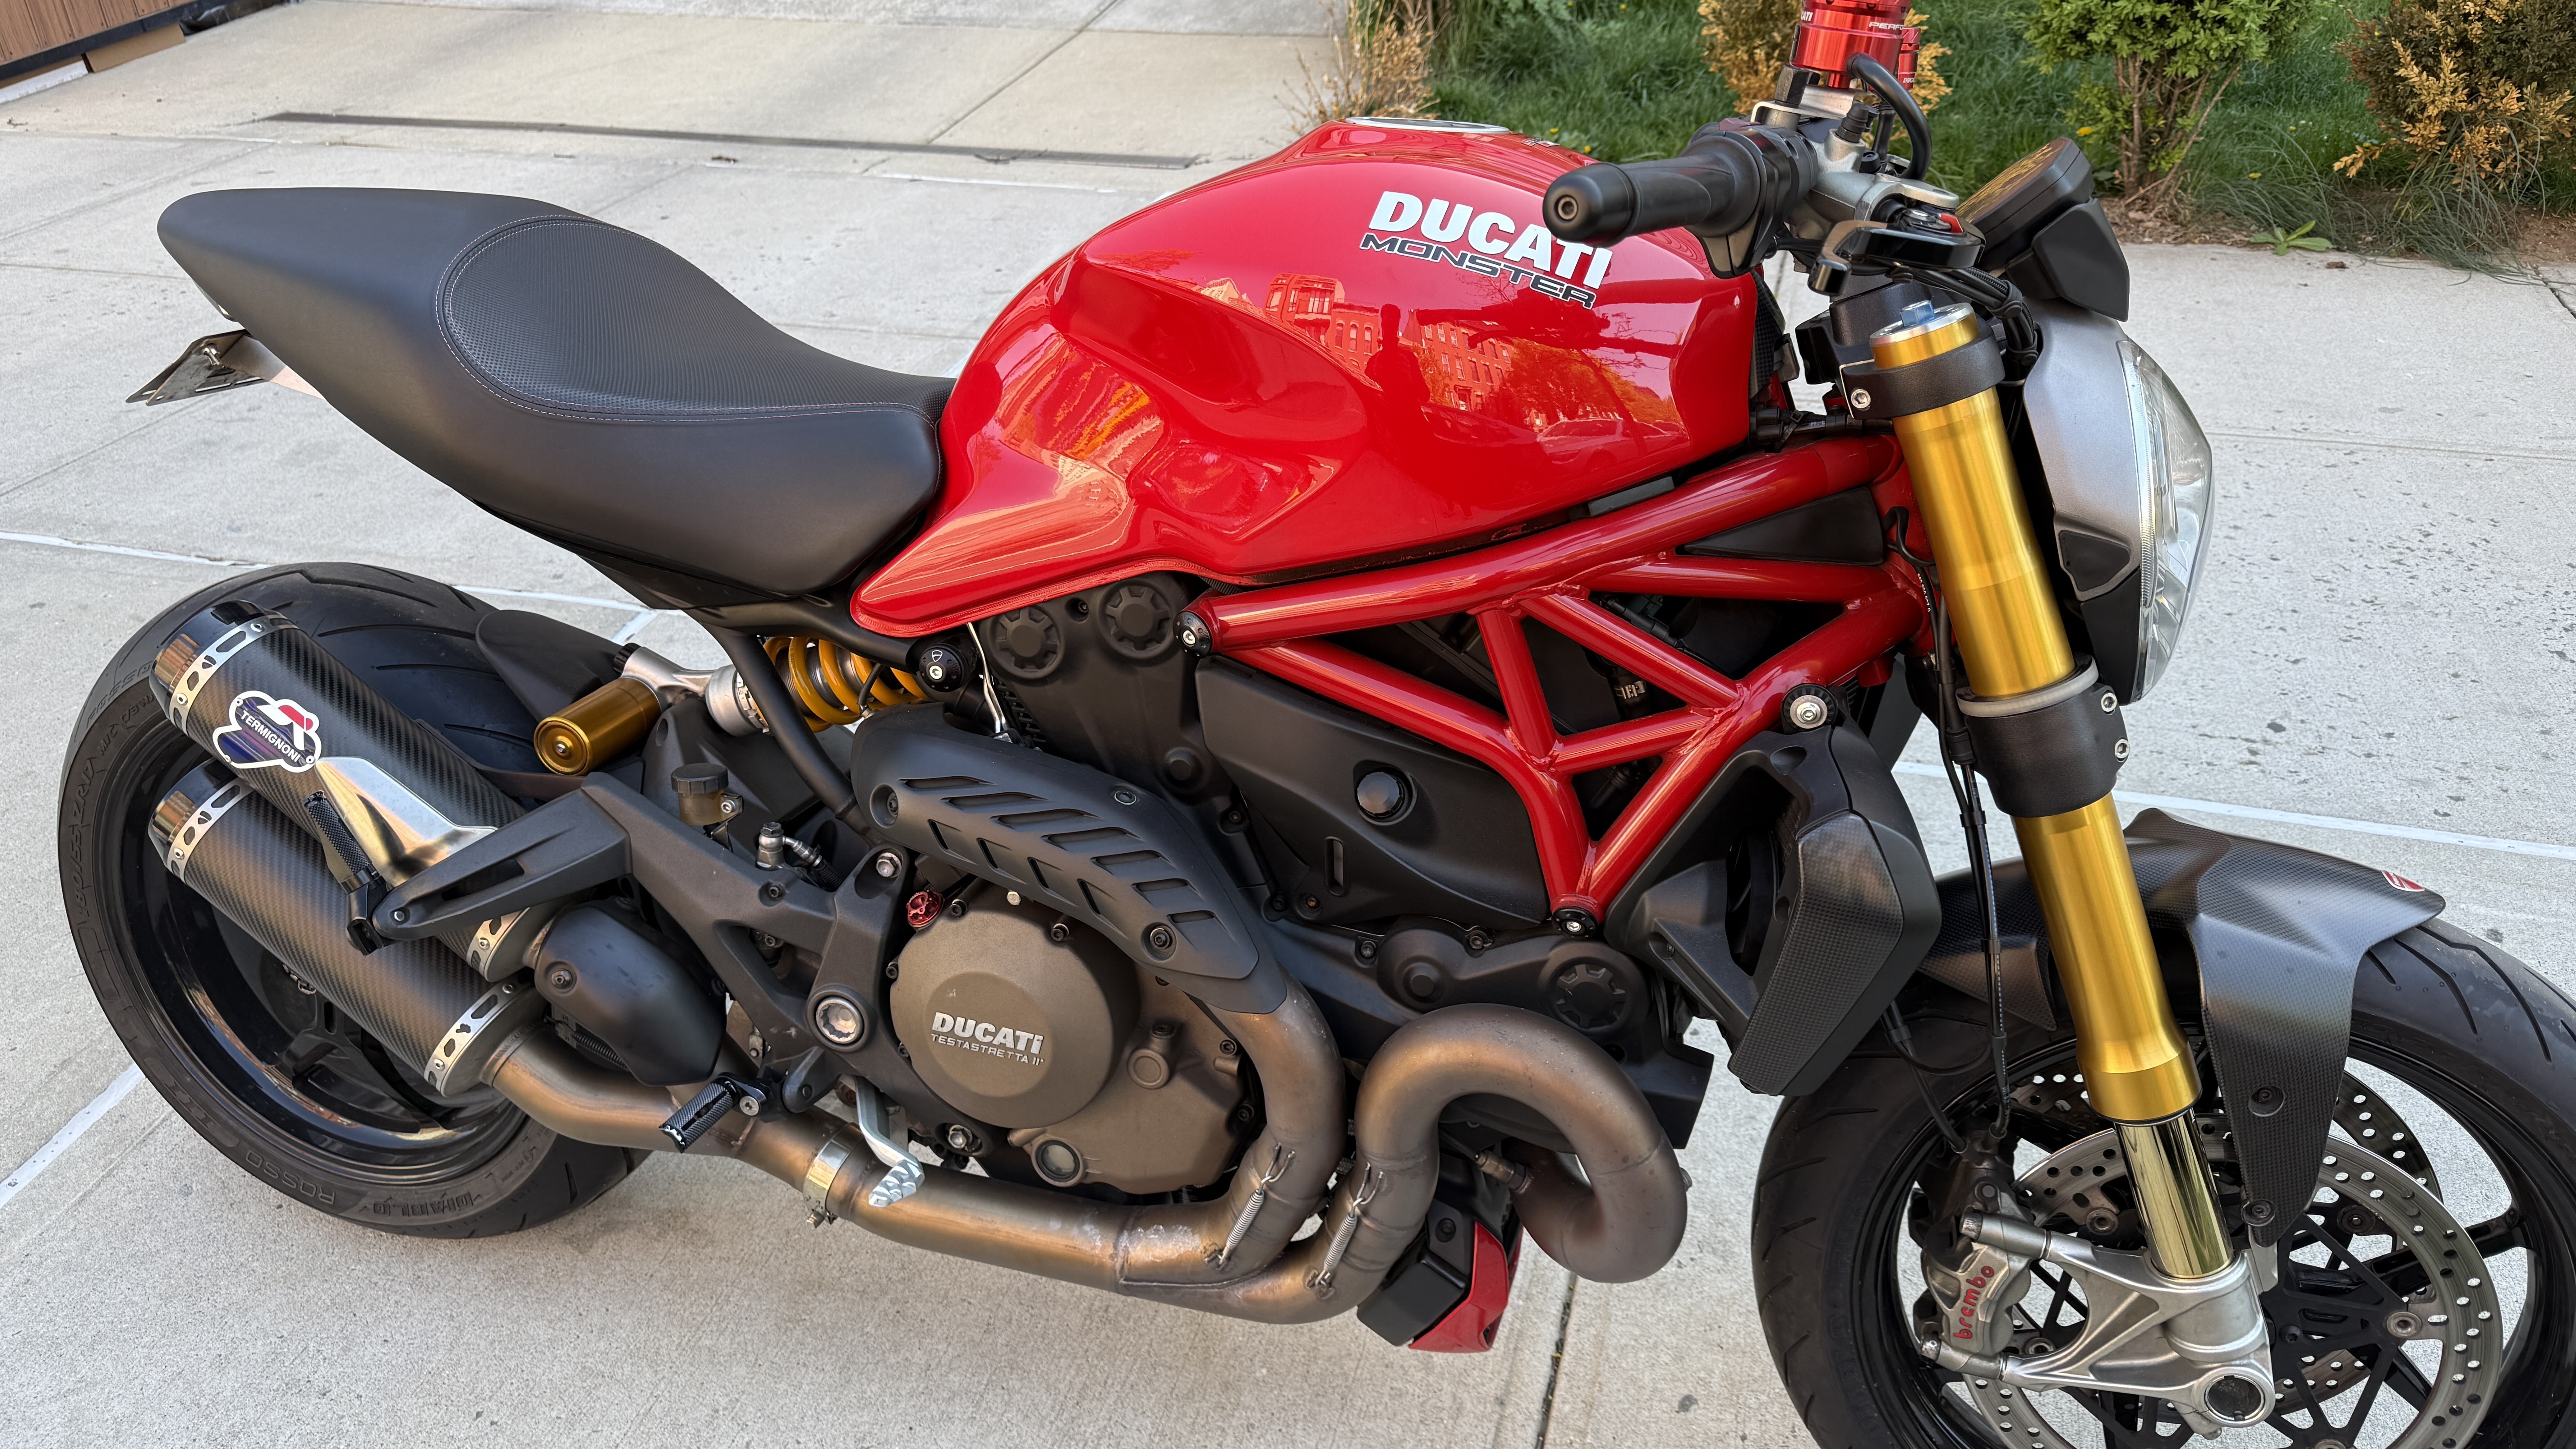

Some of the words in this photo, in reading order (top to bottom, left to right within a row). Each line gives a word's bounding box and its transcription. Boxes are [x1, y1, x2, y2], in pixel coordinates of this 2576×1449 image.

[1368, 191, 1613, 290] DUCATI
[1359, 232, 1597, 310] MONSTER
[240, 710, 301, 762] TERMIGNONI
[931, 1033, 1029, 1063] TESTASTRETTA
[932, 1012, 1044, 1054] DUCATI
[245, 1150, 336, 1205] ROSSO
[1953, 1265, 1995, 1339] brembo
